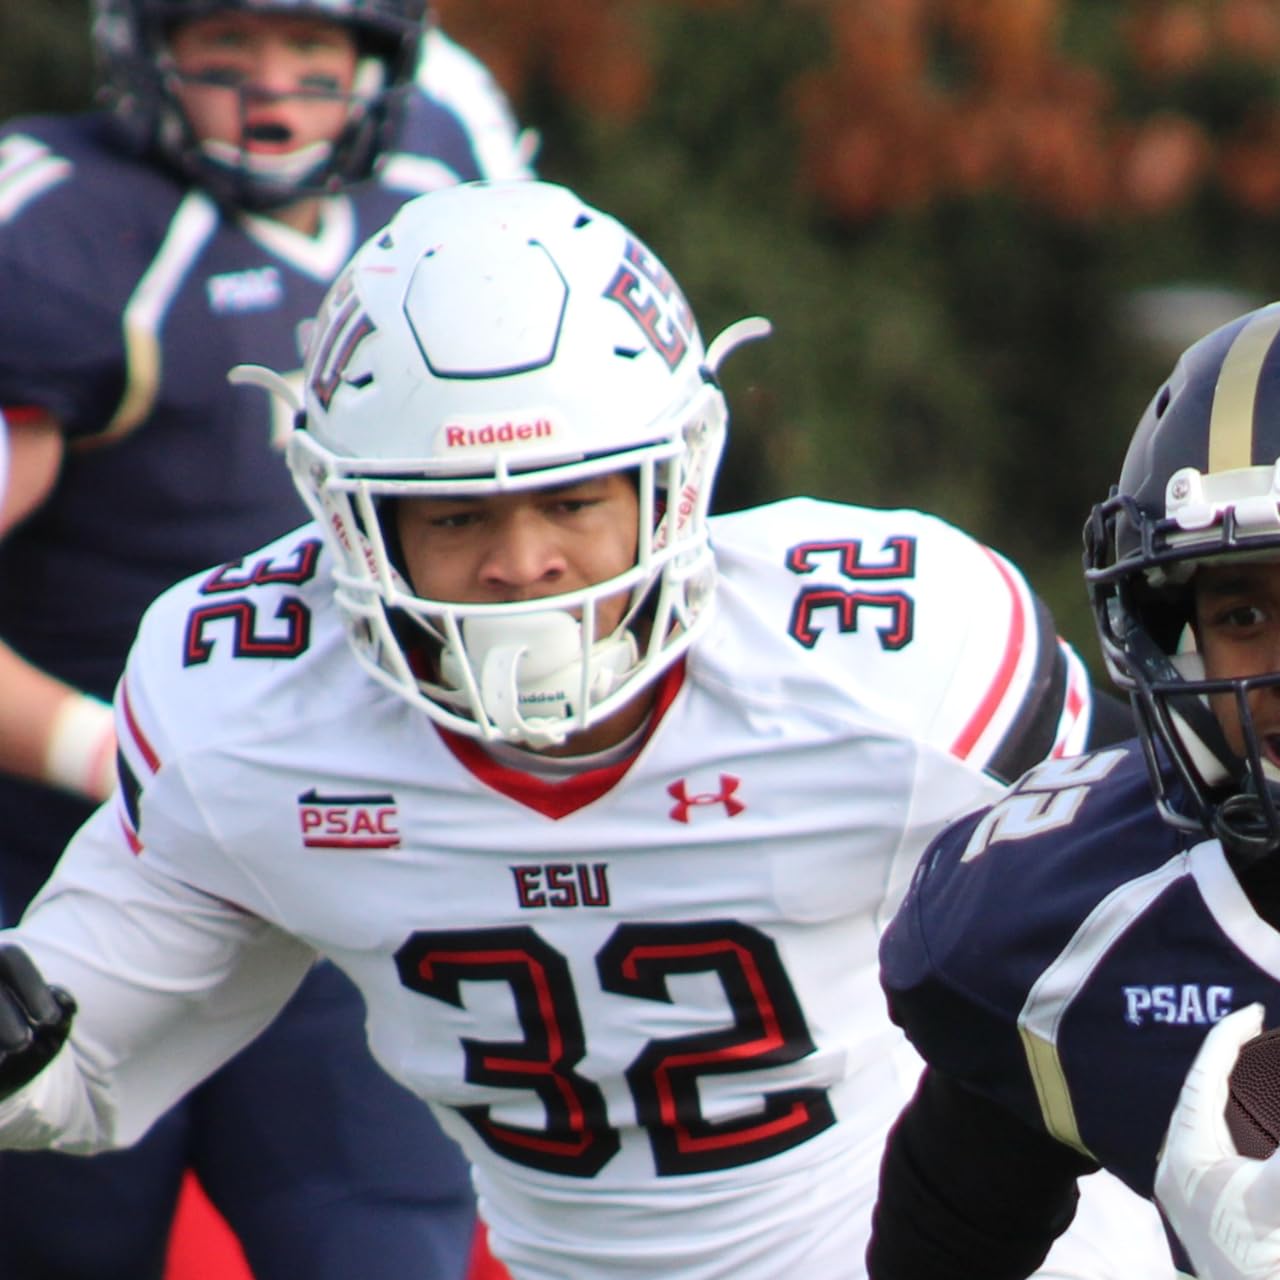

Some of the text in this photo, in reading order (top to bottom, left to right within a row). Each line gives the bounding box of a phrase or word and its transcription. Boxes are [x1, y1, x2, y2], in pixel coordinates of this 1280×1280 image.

[446, 419, 552, 447] Riddell
[183, 538, 323, 667] 32
[784, 535, 917, 651] 32
[301, 807, 399, 835] PSAC
[960, 748, 1130, 864] 22
[509, 863, 611, 908] ESU
[1122, 984, 1233, 1024] PSAC
[393, 919, 838, 1178] 32
